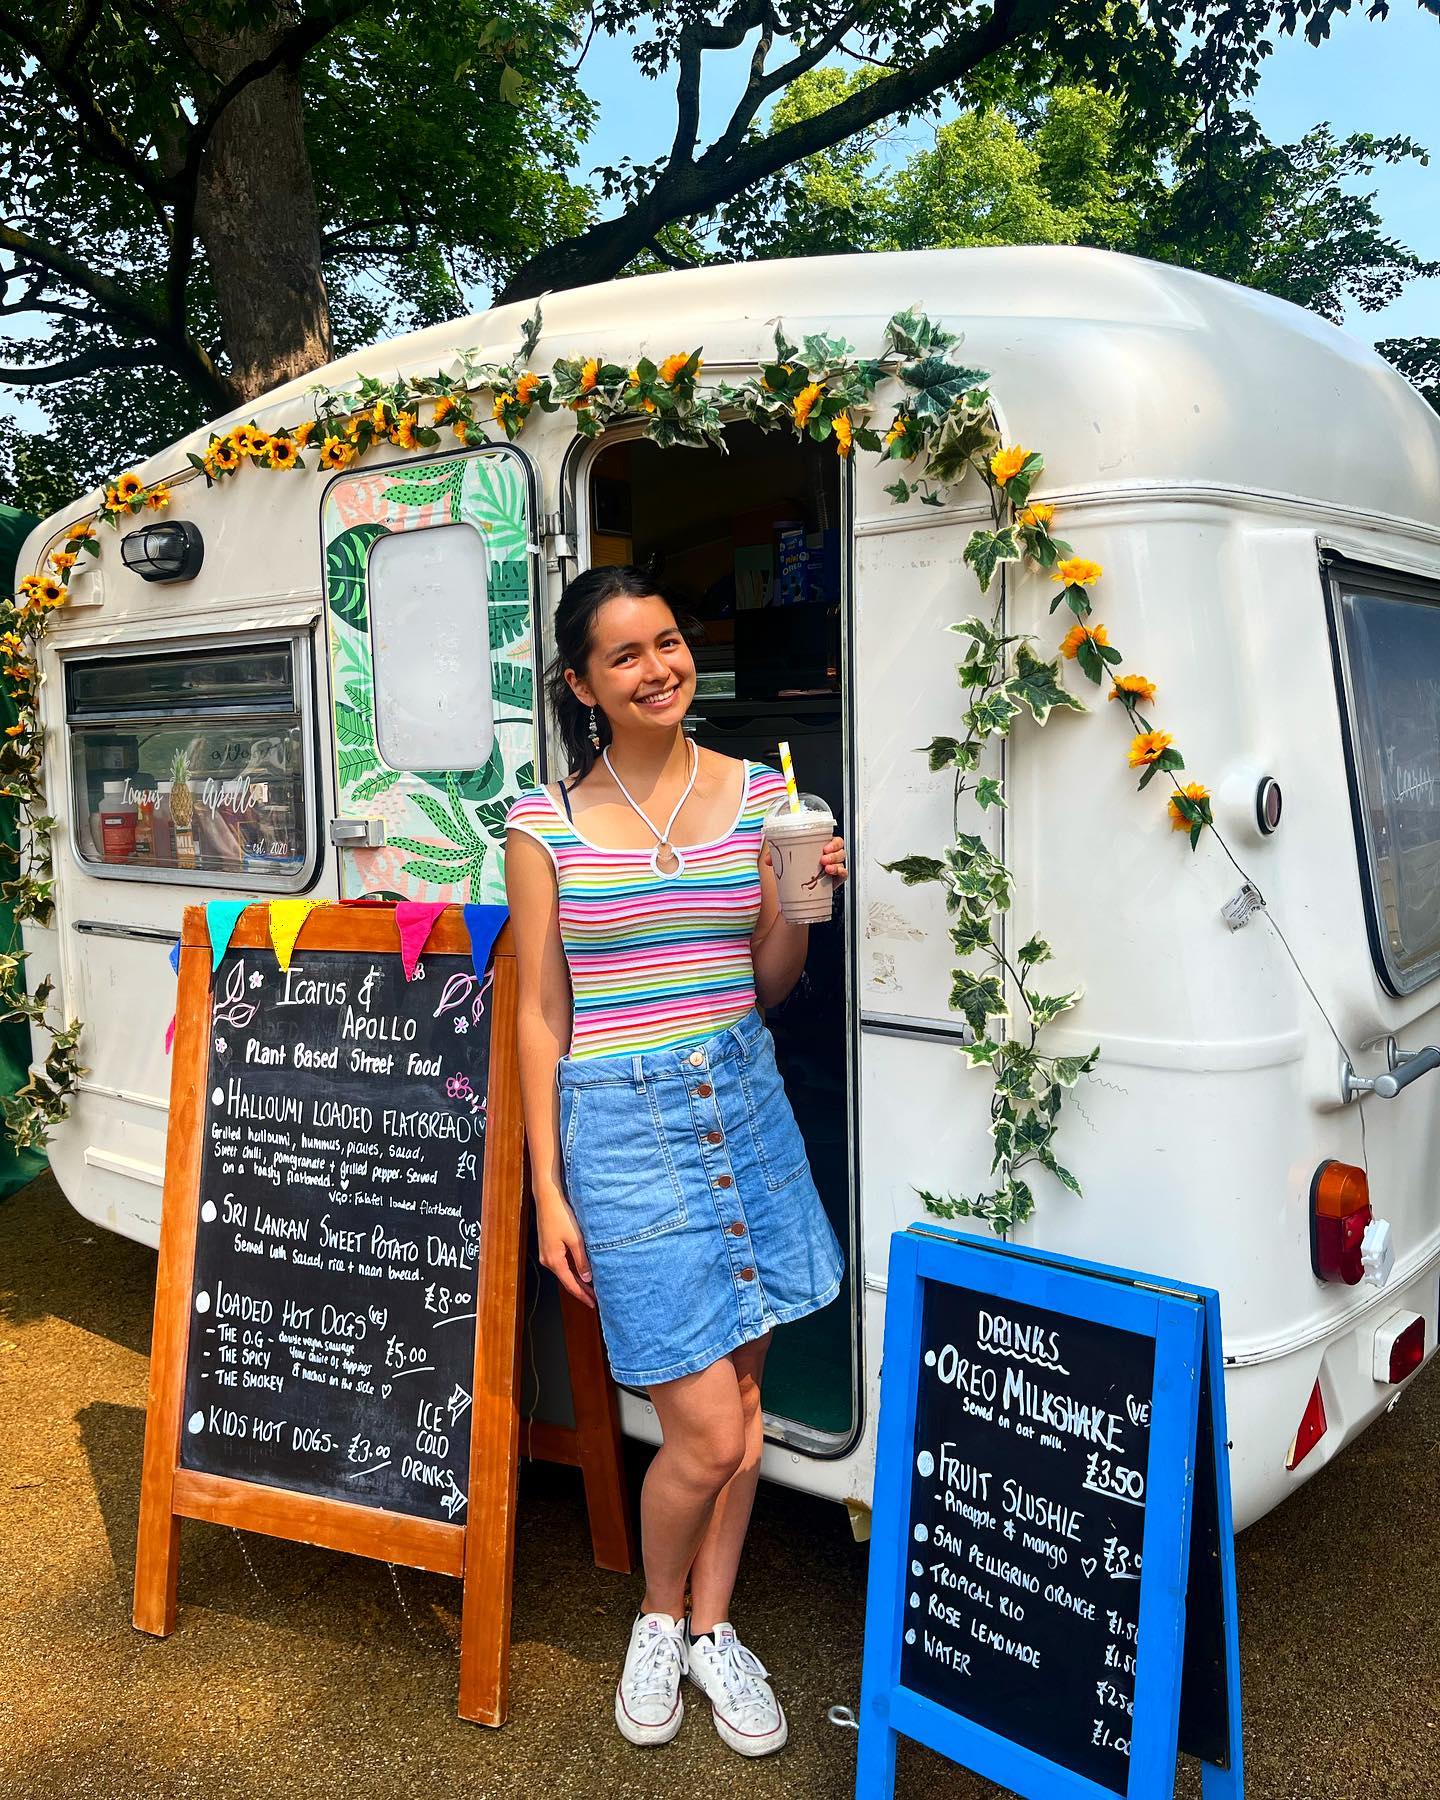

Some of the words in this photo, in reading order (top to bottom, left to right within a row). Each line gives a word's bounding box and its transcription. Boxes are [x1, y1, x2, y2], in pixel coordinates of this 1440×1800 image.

[120, 777, 164, 810] Icarus
[253, 838, 266, 854] est.
[270, 842, 288, 855] 2020
[276, 968, 346, 1005] Icarus
[358, 965, 380, 1013] &
[342, 1005, 417, 1041] APOLLO
[294, 1042, 339, 1069] Based
[350, 1048, 394, 1075] Street
[407, 1053, 442, 1076] Food
[227, 1077, 303, 1124] HALLOUMI
[313, 1100, 373, 1133] LOADED
[383, 1109, 471, 1143] FLATBREAD
[211, 1122, 241, 1140] Grilled
[248, 1126, 296, 1151] halloumi,
[301, 1132, 344, 1155] hummus,
[222, 1162, 235, 1175] on
[238, 1163, 245, 1174] a
[253, 1162, 281, 1186] toasty
[273, 1151, 326, 1171] pomegranate
[330, 1160, 336, 1173] +
[372, 1166, 403, 1183] pepper.
[406, 1168, 438, 1185] Served
[456, 1150, 477, 1181] £9
[354, 1191, 383, 1206] Falafel
[389, 1196, 416, 1211] loaded
[420, 1200, 462, 1218] flatbread
[222, 1192, 248, 1227] SRI
[254, 1206, 310, 1242] LANKAN
[319, 1213, 367, 1253] SWEET
[371, 1224, 419, 1262] POTATO
[427, 1235, 472, 1271] DAAL
[234, 1233, 264, 1255] Served
[269, 1244, 287, 1260] with
[328, 1258, 345, 1271] rice
[347, 1261, 355, 1273] +
[358, 1263, 383, 1278] naan
[388, 1265, 425, 1281] bread.
[216, 1280, 273, 1324] LOADED
[282, 1300, 315, 1330] HOT
[321, 1304, 366, 1340] DOGS
[368, 1304, 388, 1331] (VE)
[424, 1282, 472, 1314] £8.00
[217, 1323, 237, 1342] THE
[303, 1337, 323, 1352] vegan
[324, 1341, 355, 1356] sausage
[385, 1334, 427, 1369] £5.00
[978, 1310, 1060, 1362] DRINKS
[218, 1345, 237, 1364] THE
[241, 1348, 271, 1370] SPICY
[341, 1359, 373, 1376] toppings
[215, 1369, 238, 1387] THE
[242, 1371, 284, 1393] SMOKEY
[292, 1362, 301, 1377] &
[302, 1367, 326, 1383] nachos
[341, 1378, 353, 1391] the
[355, 1381, 375, 1395] side
[417, 1398, 444, 1433] ICE
[937, 1344, 997, 1401] OREO
[1003, 1366, 1125, 1453] MILKSHAKE
[209, 1405, 249, 1438] KIDS
[253, 1417, 288, 1443] HOT
[348, 1433, 391, 1463] £3.00
[416, 1429, 449, 1459] COLD
[999, 1415, 1010, 1429] on
[1016, 1422, 1035, 1439] oat
[401, 1455, 454, 1488] DRINKS
[1086, 1452, 1144, 1498] £3.50
[939, 1441, 993, 1501] FRUIT
[1002, 1478, 1085, 1543] SLUSHIE
[1003, 1519, 1016, 1541] &
[1022, 1532, 1068, 1570] mango
[933, 1524, 962, 1557] SAN
[968, 1544, 1040, 1593] PELLIGRINO
[1044, 1584, 1096, 1621] ORANGE
[930, 1562, 993, 1609] TROPICAL
[999, 1595, 1025, 1622] RIO
[928, 1593, 962, 1629] ROSE
[971, 1618, 1041, 1670] LEMONADE
[924, 1630, 972, 1676] WATER
